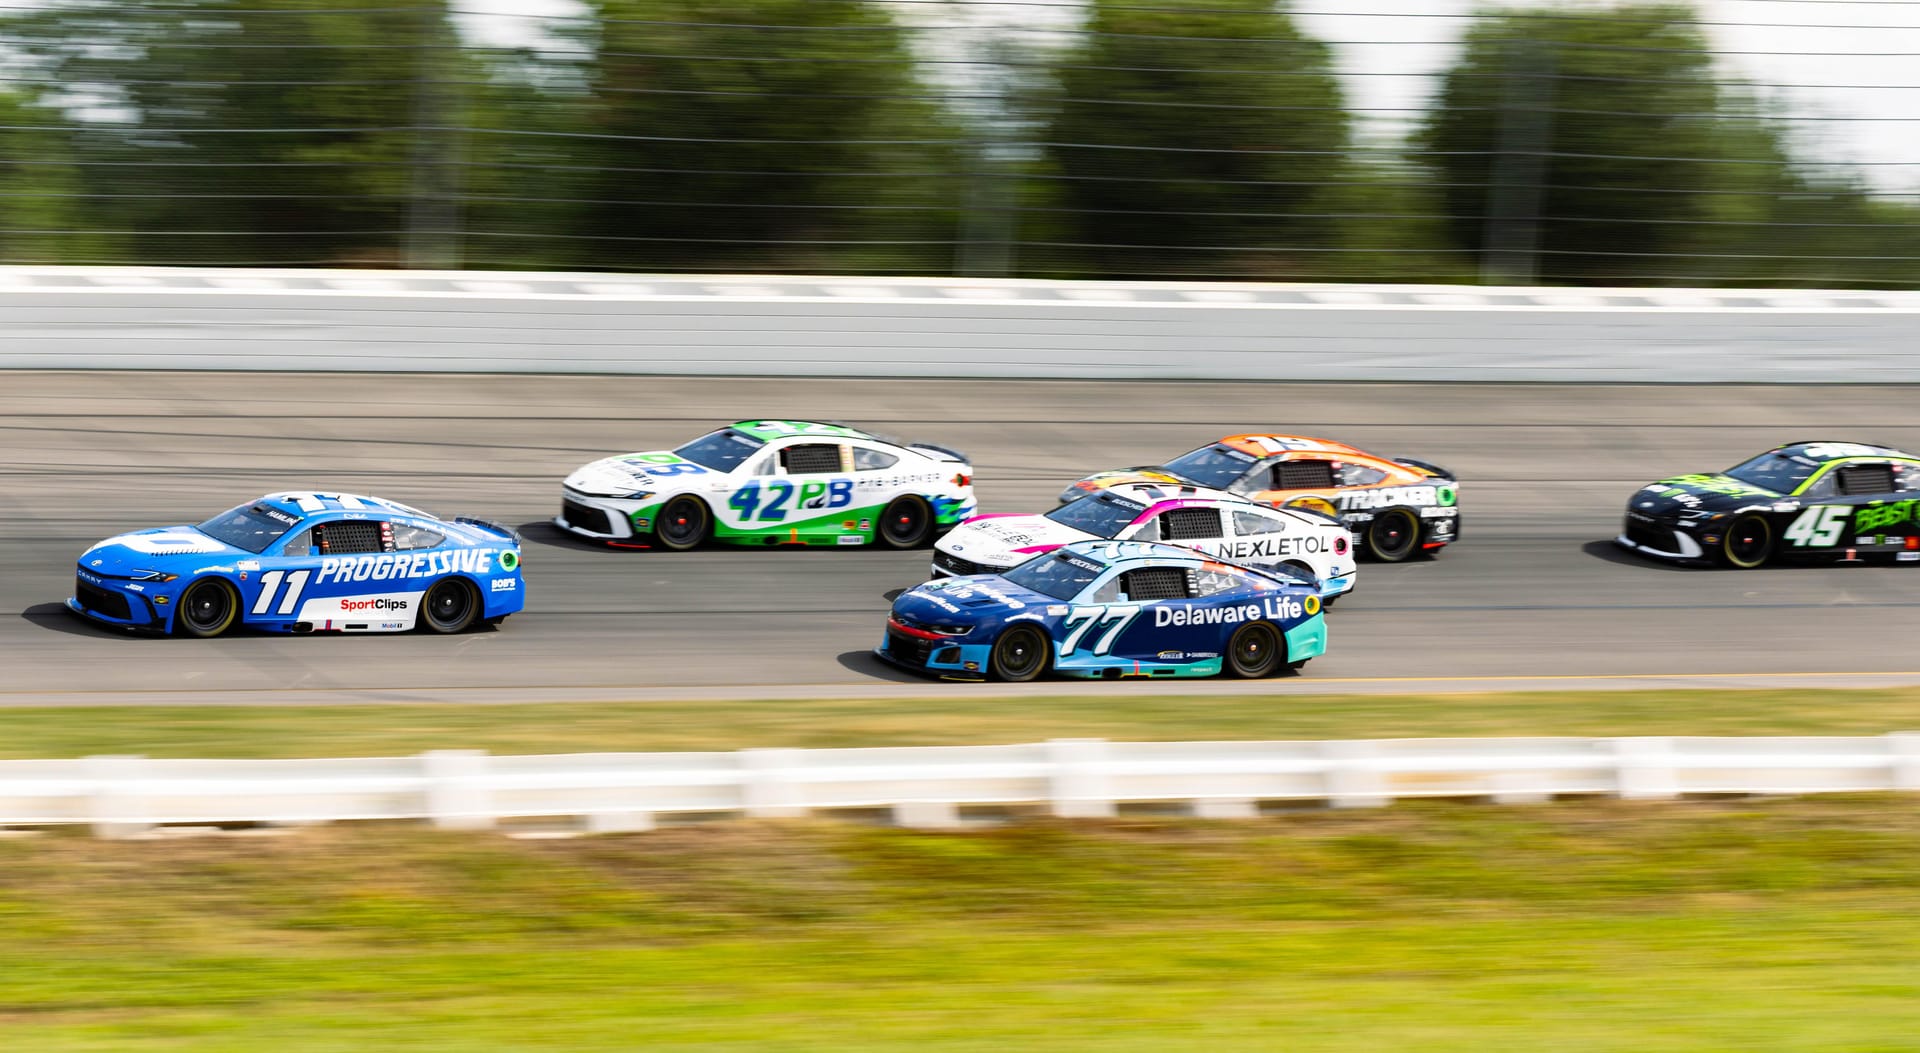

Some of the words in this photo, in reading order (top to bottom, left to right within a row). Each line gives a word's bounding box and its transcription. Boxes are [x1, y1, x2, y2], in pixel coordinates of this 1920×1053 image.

[730, 479, 794, 522] 42
[1335, 486, 1437, 510] TRACKER
[1783, 505, 1854, 547] 45
[1218, 536, 1329, 558] NEXLETOL
[251, 570, 311, 615] 11
[315, 547, 494, 585] PROGRESSIVE
[340, 598, 408, 612] SportClips
[1154, 602, 1262, 627] Delaware
[1263, 596, 1302, 620] Life
[1059, 605, 1142, 657] 77
